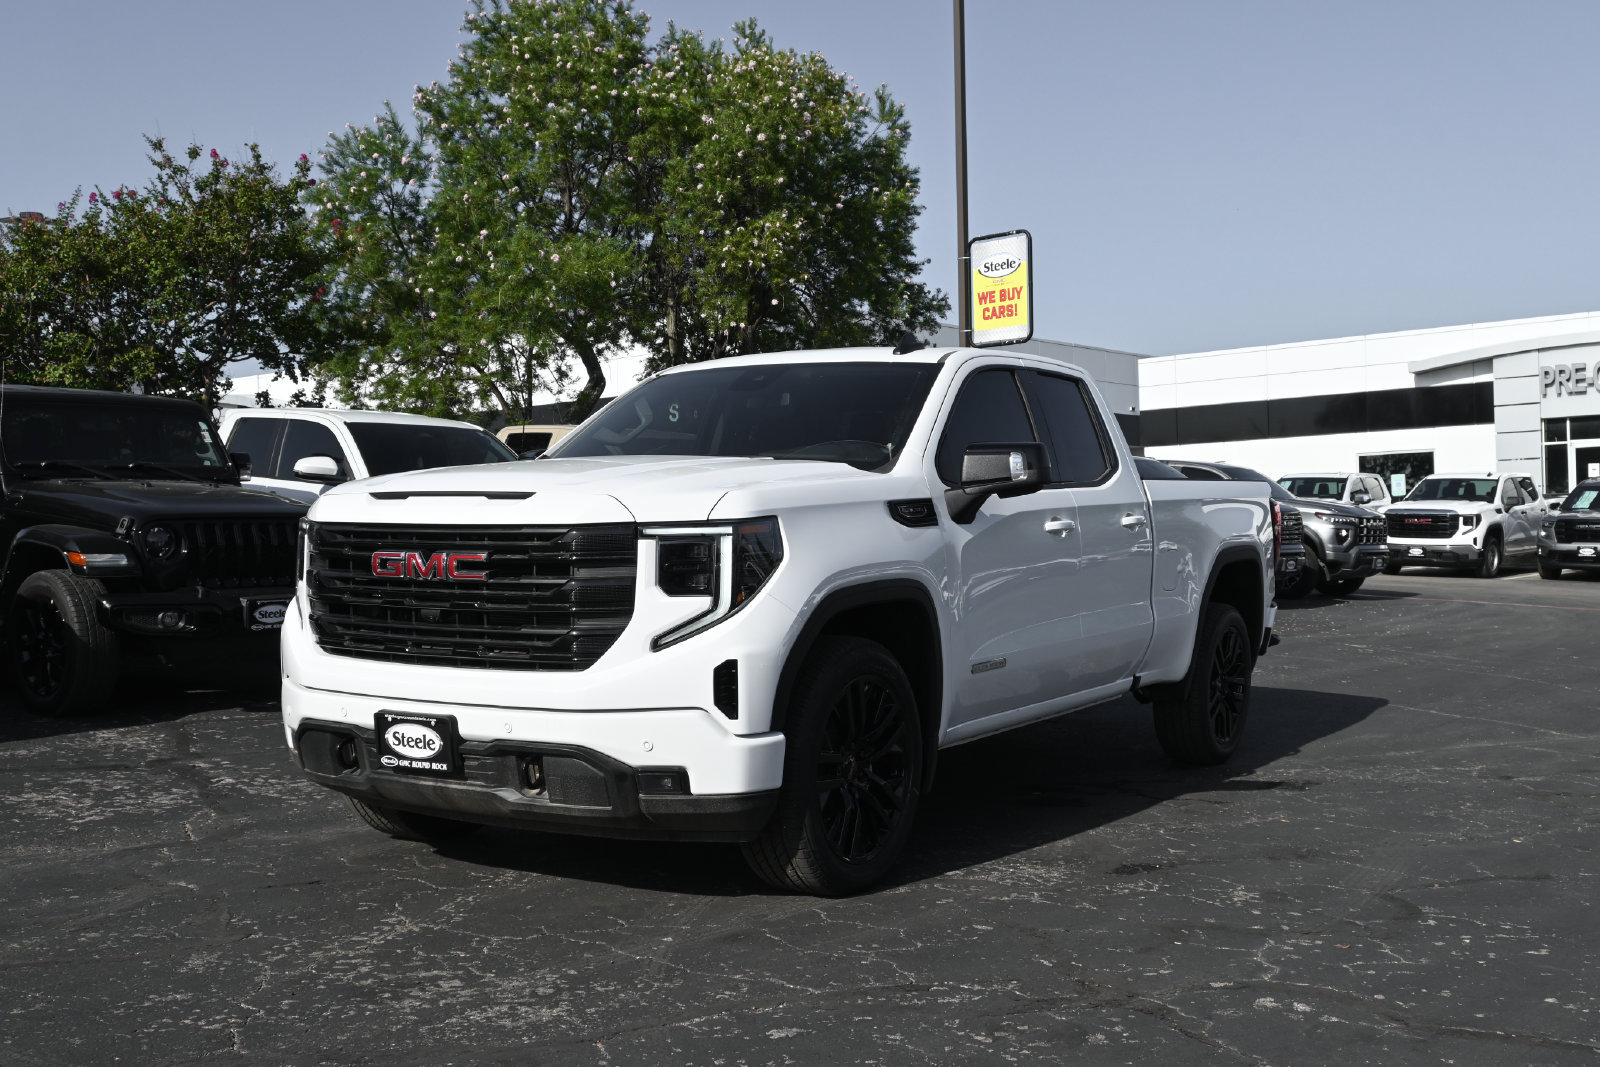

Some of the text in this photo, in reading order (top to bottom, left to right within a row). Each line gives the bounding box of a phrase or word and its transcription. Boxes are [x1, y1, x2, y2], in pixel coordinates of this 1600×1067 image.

[983, 259, 1016, 272] Steele
[977, 286, 1023, 305] WE BUY
[982, 303, 1017, 320] CARS!
[372, 552, 488, 580] GMC
[392, 731, 435, 750] Steele
